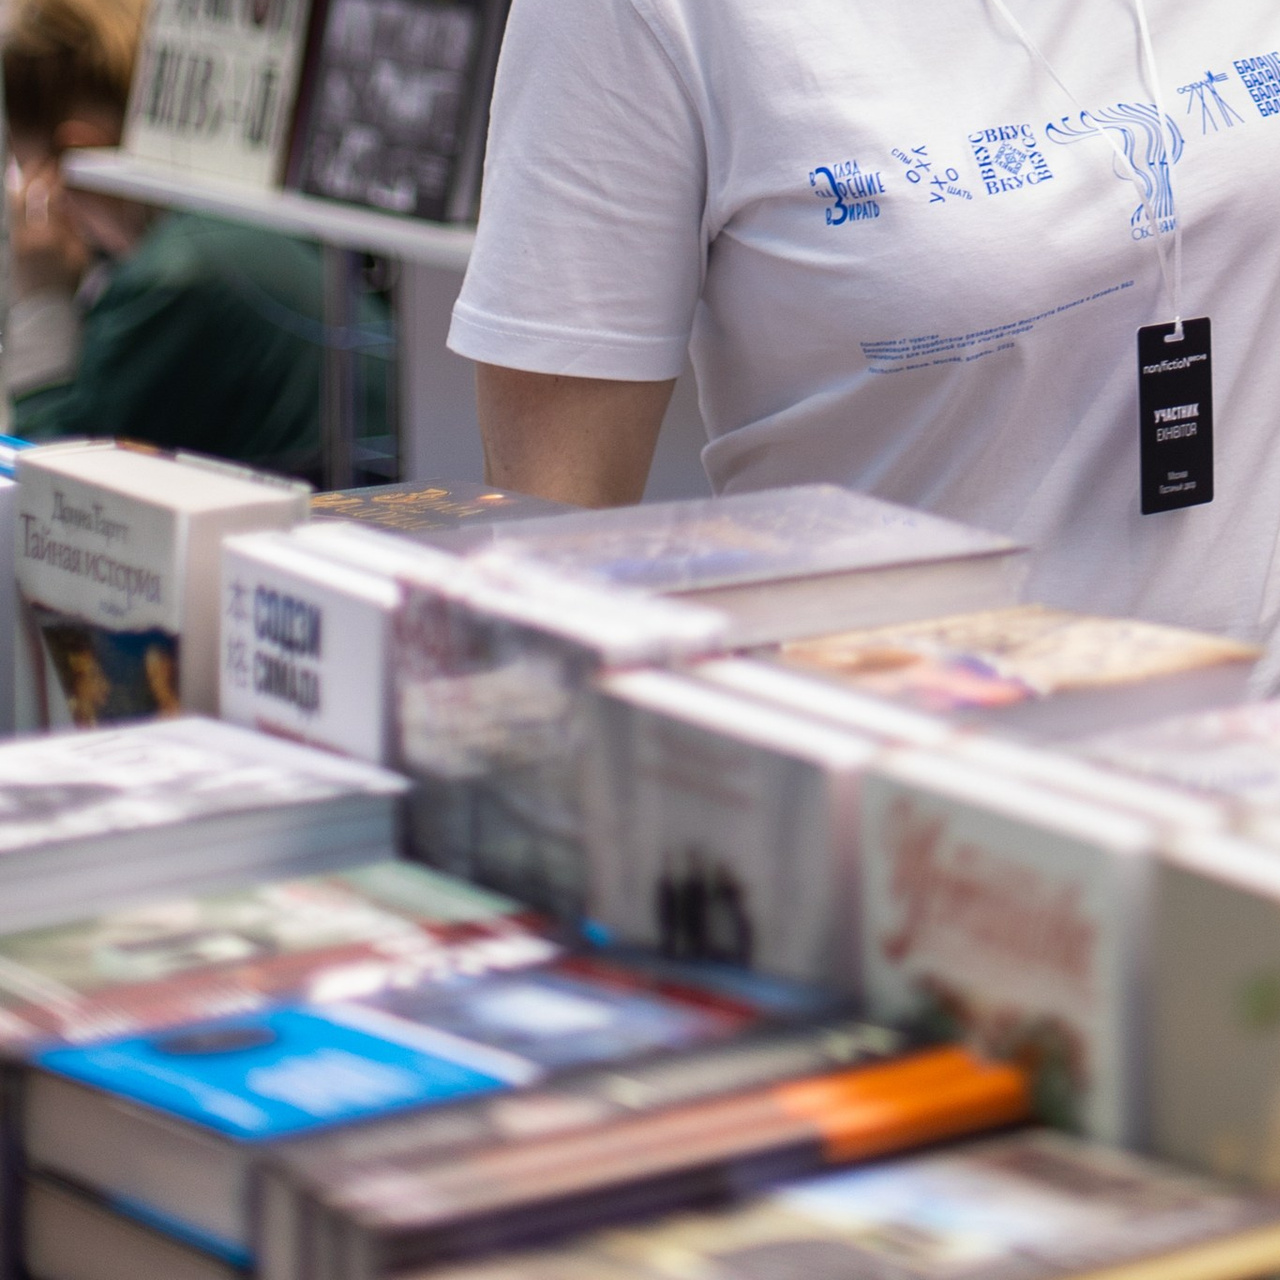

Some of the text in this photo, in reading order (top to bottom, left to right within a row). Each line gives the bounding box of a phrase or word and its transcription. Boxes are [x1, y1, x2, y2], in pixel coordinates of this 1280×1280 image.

[984, 124, 1034, 143] ВКУС
[968, 131, 997, 180] ВКУС
[1022, 137, 1054, 181] ВКУС
[985, 174, 1042, 196] ВКУС
[1153, 402, 1200, 424] УЧАСТНИК
[1156, 422, 1198, 442] EXHIBITOR
[53, 490, 129, 544] Донна Тартт
[20, 512, 161, 610] Тайная история
